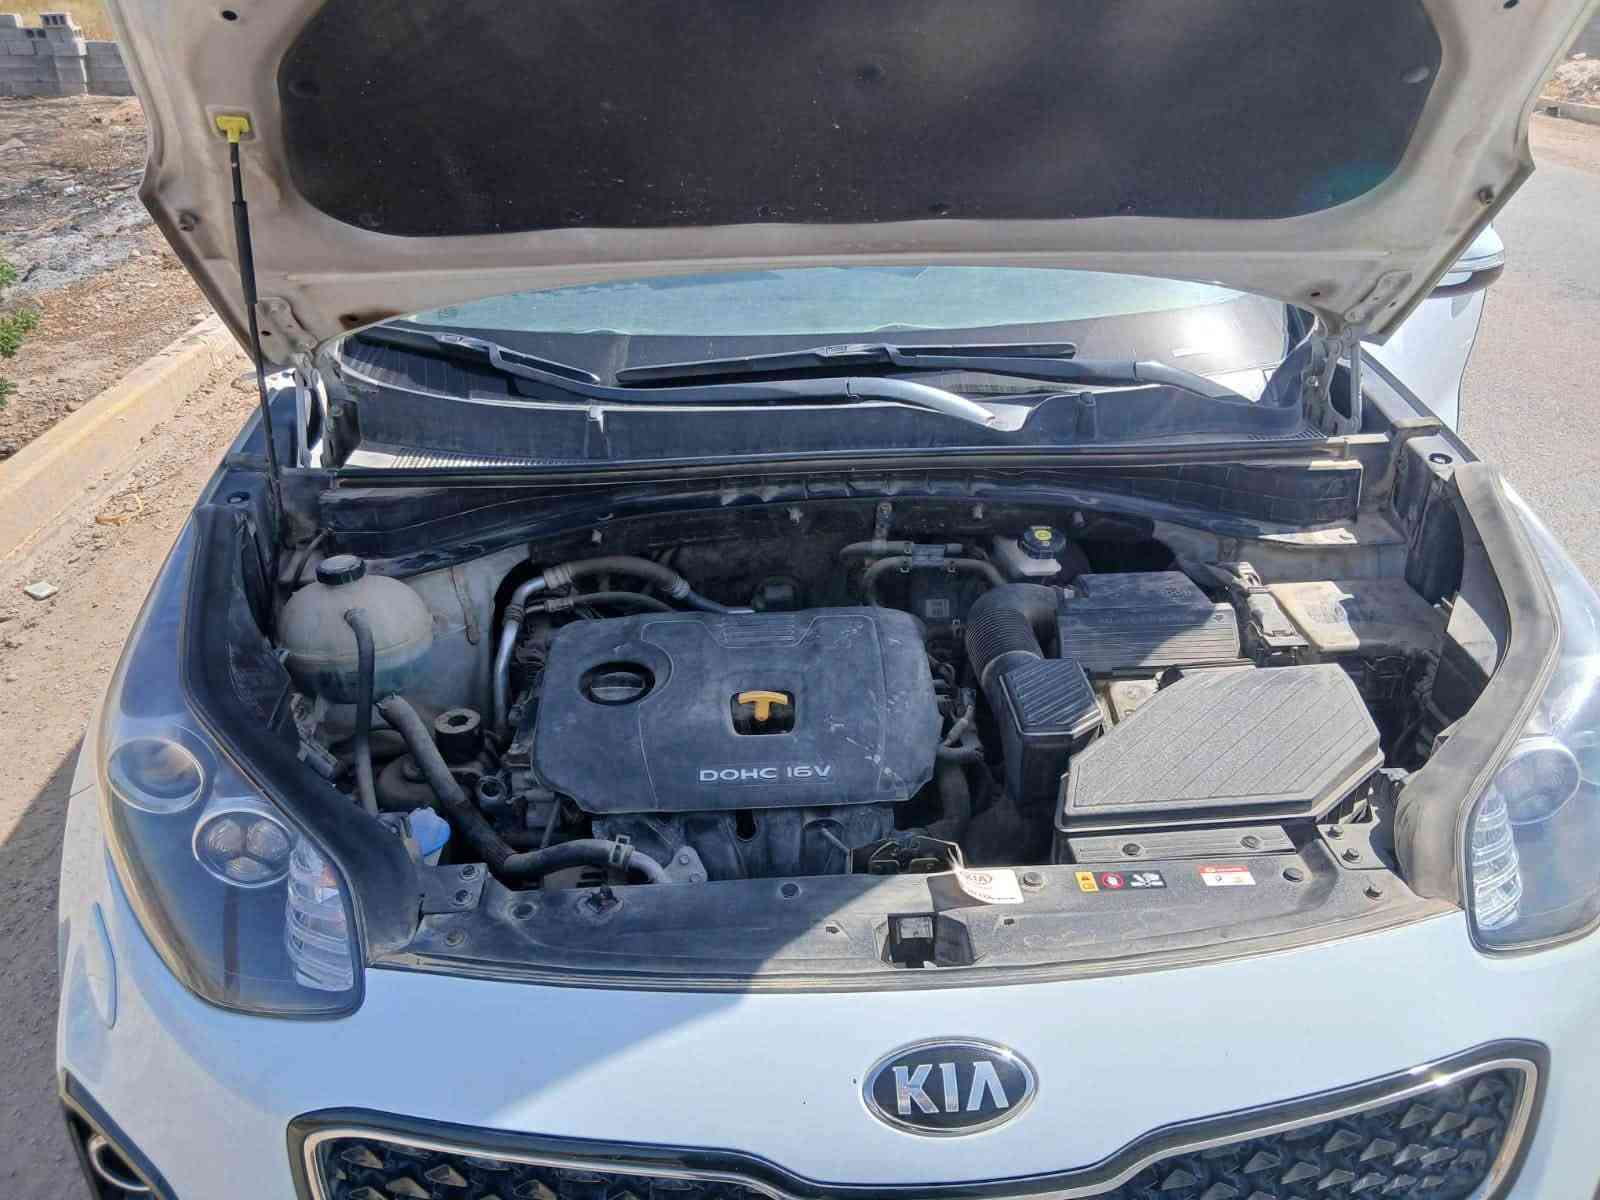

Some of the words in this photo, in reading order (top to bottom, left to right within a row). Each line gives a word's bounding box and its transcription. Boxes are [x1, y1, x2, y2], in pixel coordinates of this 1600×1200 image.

[698, 767, 777, 782] DOHC
[786, 764, 832, 779] 16V
[892, 1061, 1010, 1115] KIA
